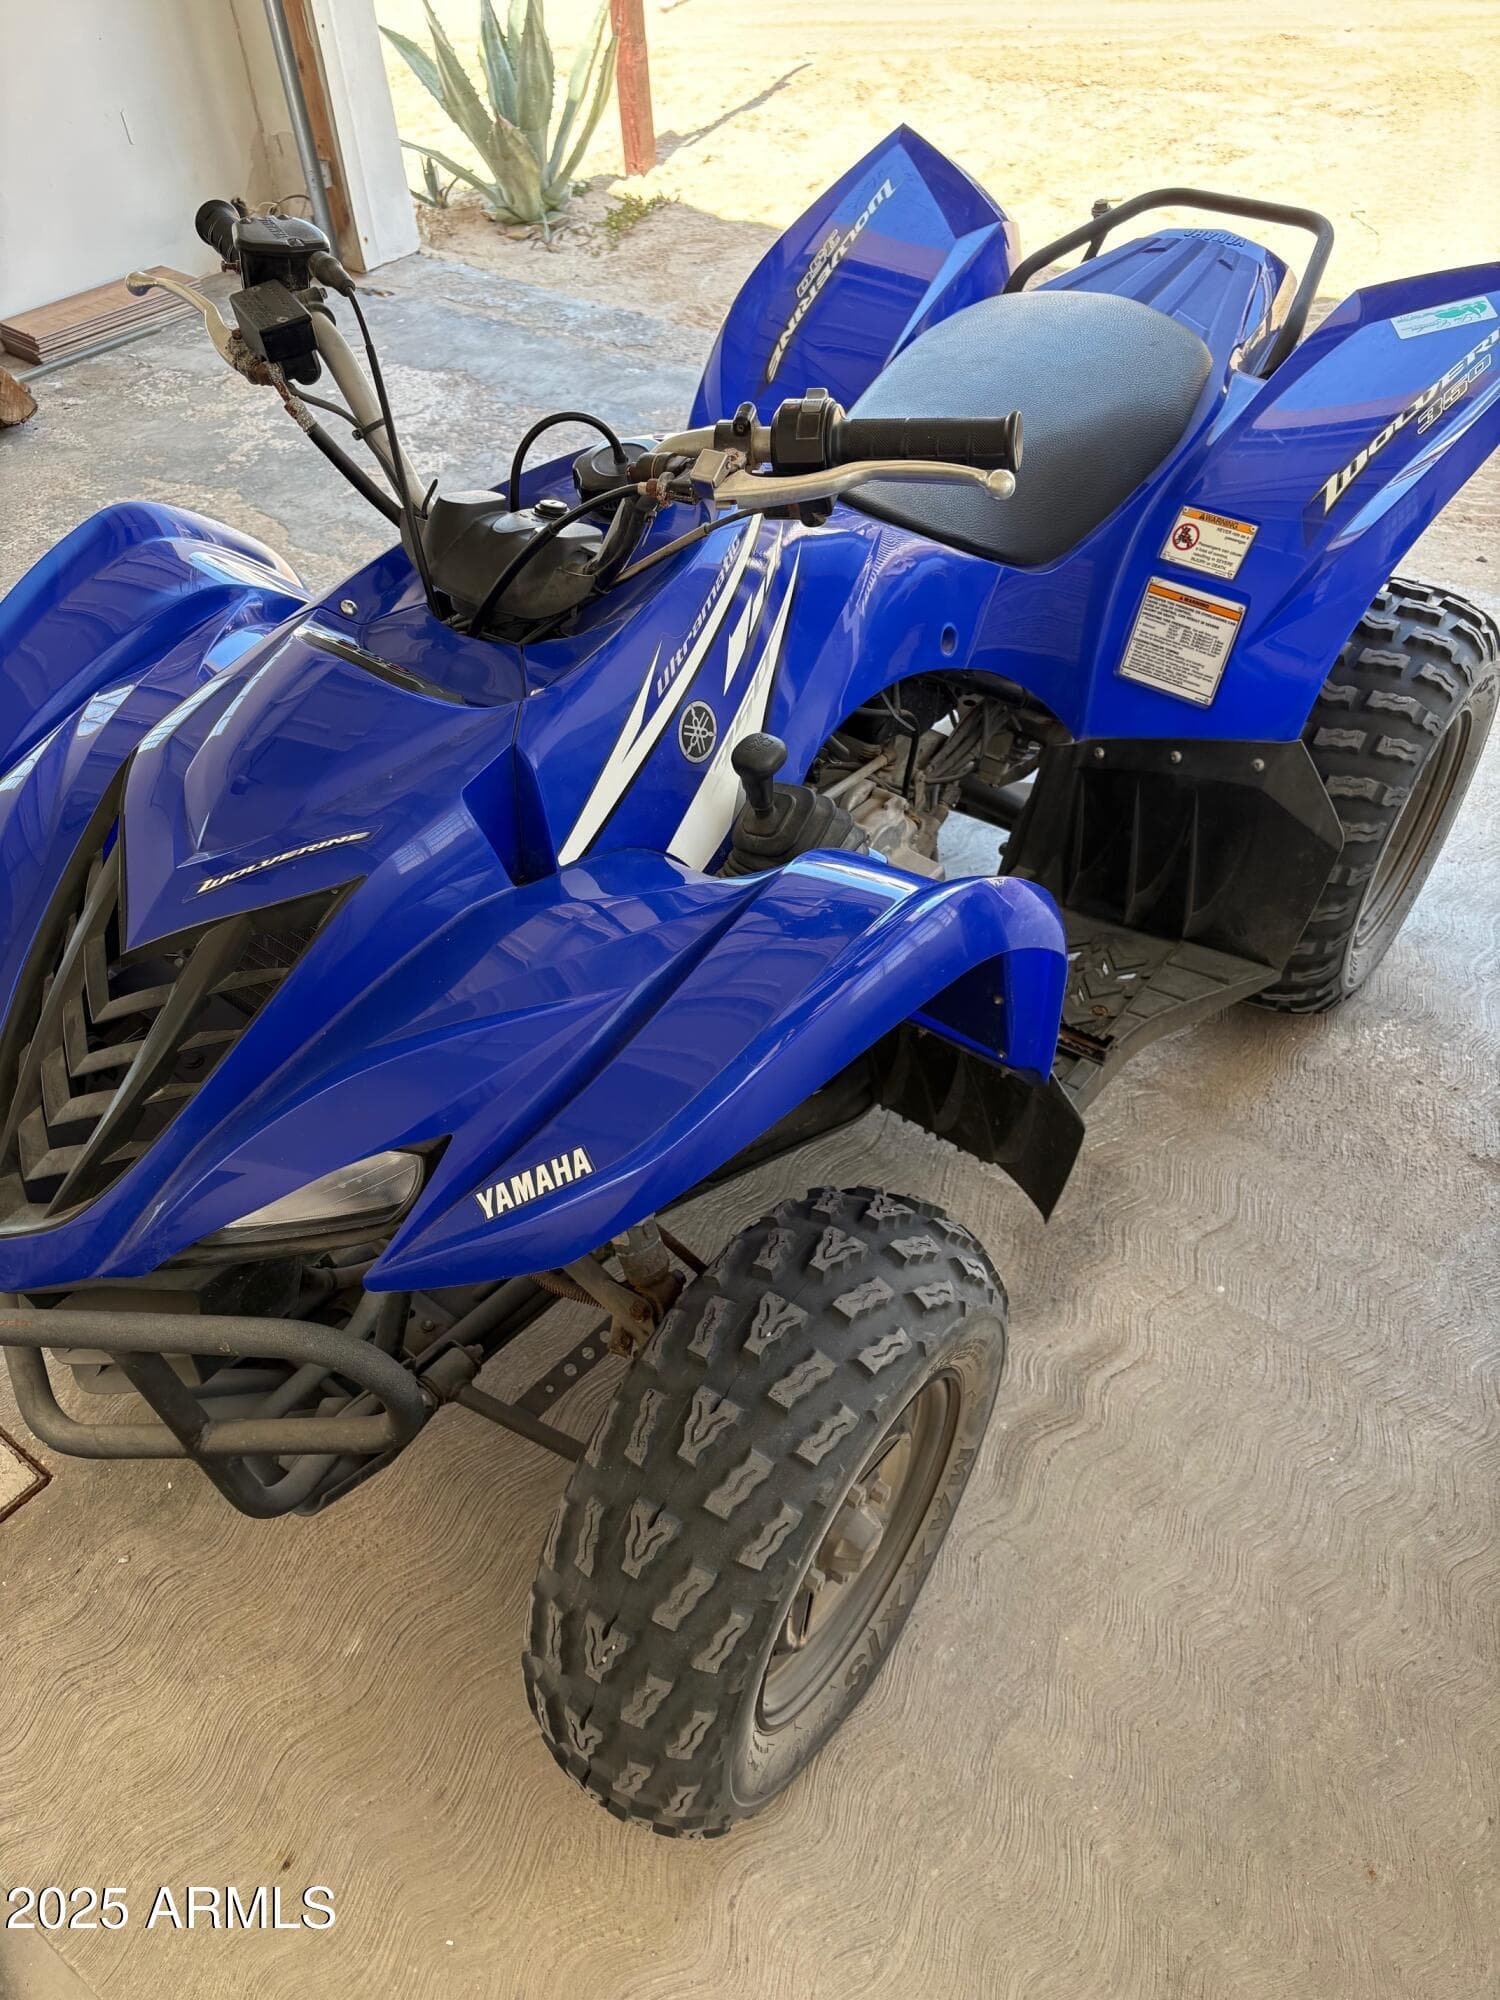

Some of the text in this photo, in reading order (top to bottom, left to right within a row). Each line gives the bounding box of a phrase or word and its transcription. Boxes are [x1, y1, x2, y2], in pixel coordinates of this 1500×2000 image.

[767, 178, 896, 384] WOLVERINE
[1417, 353, 1492, 435] 350
[1205, 514, 1239, 529] WARNING
[657, 533, 741, 698] Ultramatic
[197, 832, 370, 894] WOLVERINE
[475, 1147, 593, 1219] YAMAHA
